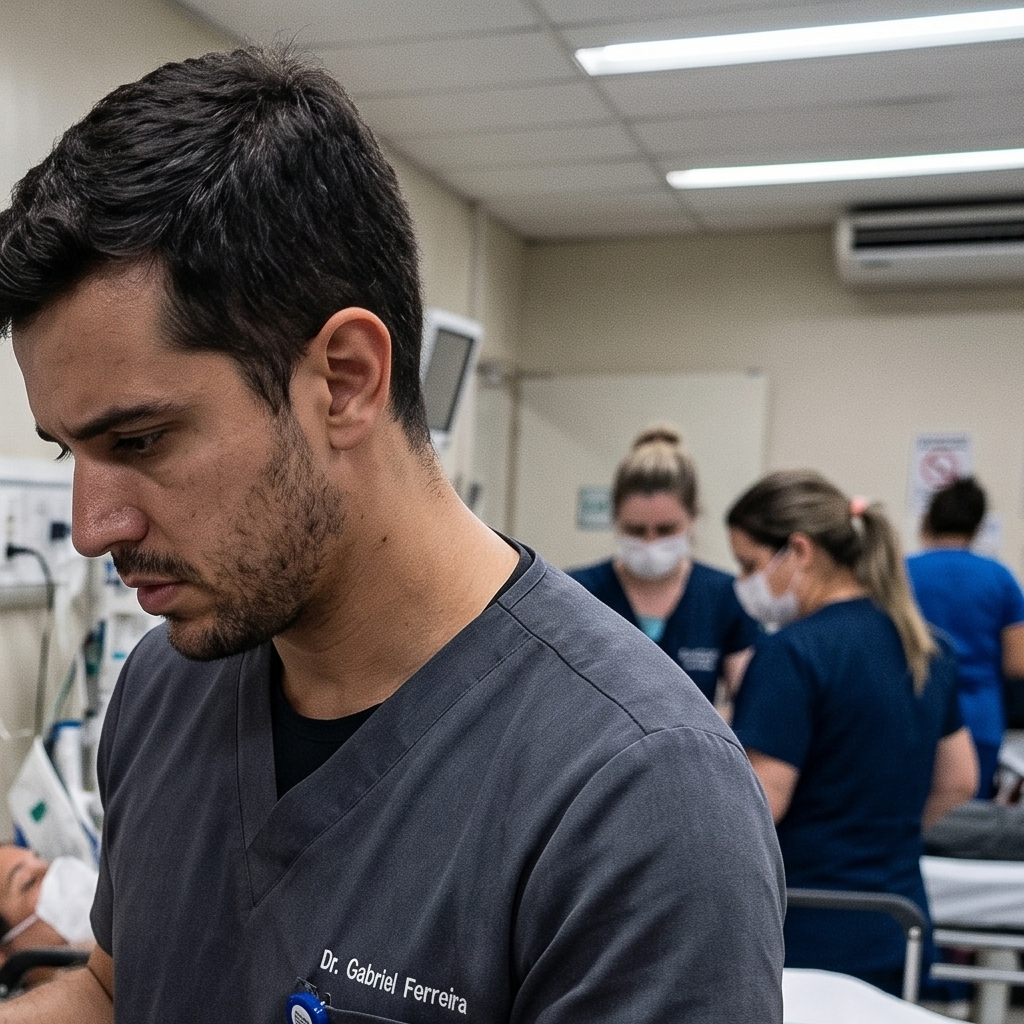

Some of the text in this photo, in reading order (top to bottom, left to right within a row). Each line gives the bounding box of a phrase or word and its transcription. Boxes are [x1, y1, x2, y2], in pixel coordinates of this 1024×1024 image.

[320, 948, 468, 1015] Dr. Gabriel Ferreira
